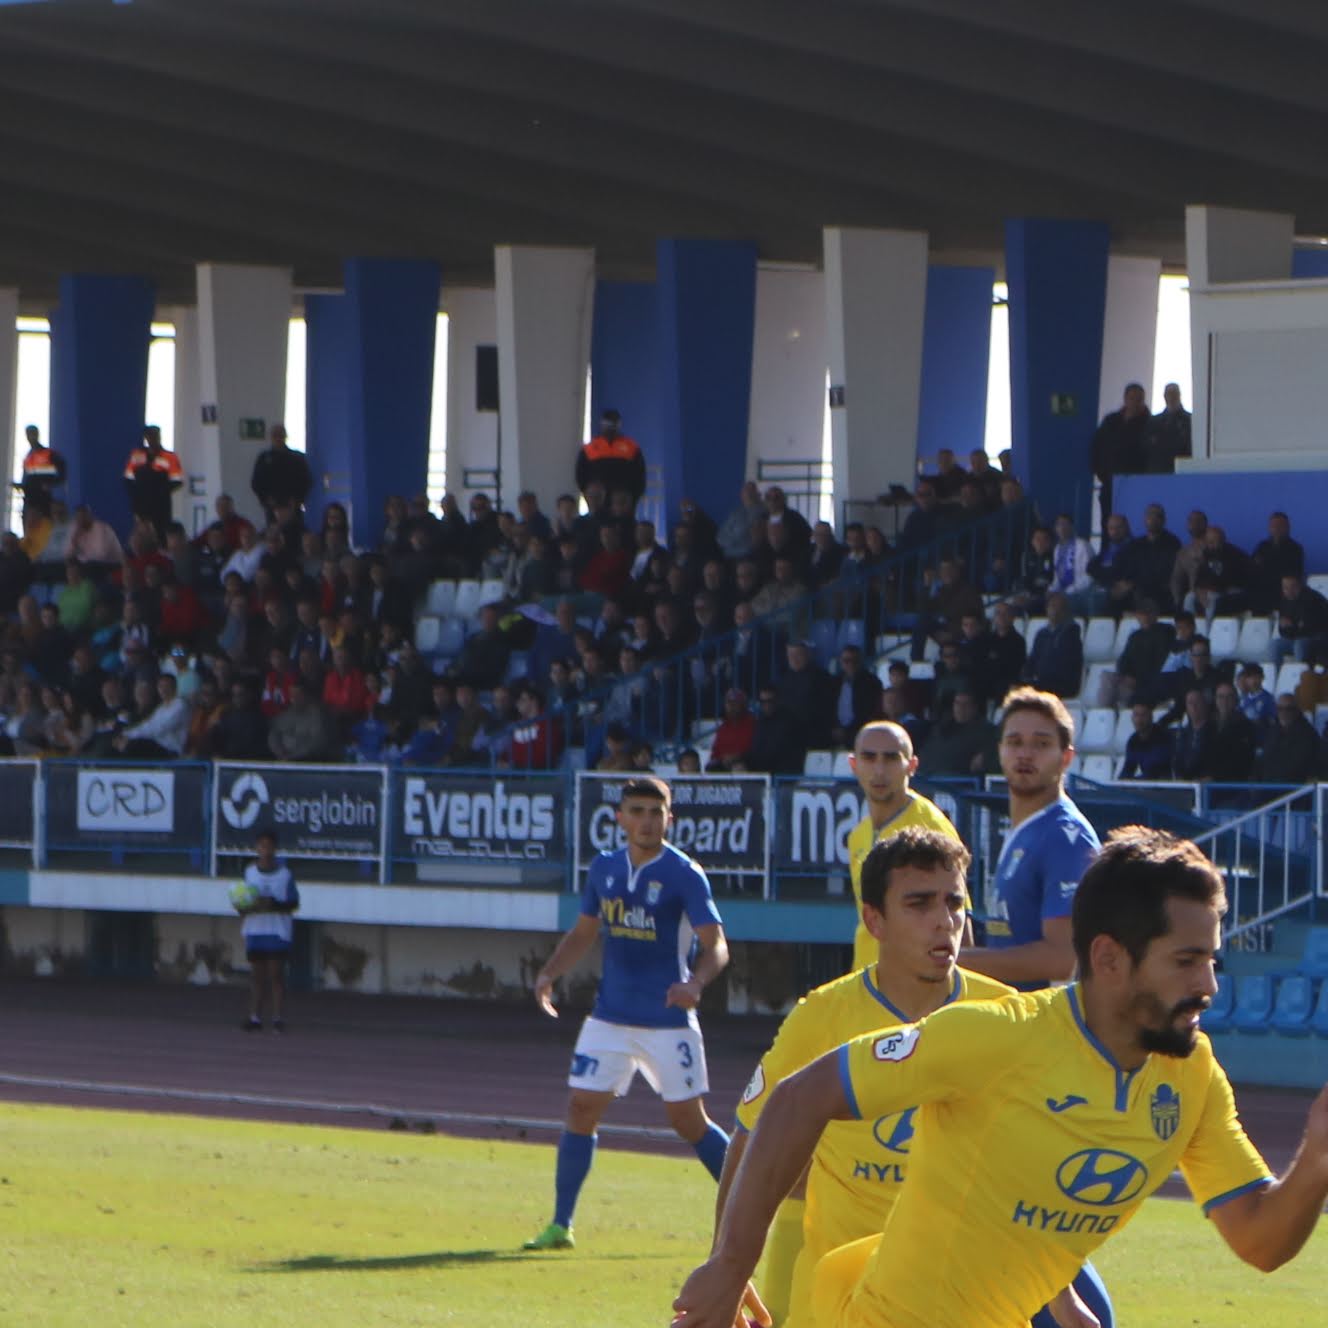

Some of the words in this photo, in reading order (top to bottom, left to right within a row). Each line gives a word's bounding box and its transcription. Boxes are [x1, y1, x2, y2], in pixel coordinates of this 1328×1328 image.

[86, 779, 167, 818] CRD
[274, 793, 376, 833] serglobin
[404, 777, 554, 840] Eventos
[677, 1041, 693, 1068] 3
[1012, 1200, 1119, 1234] HYUND
